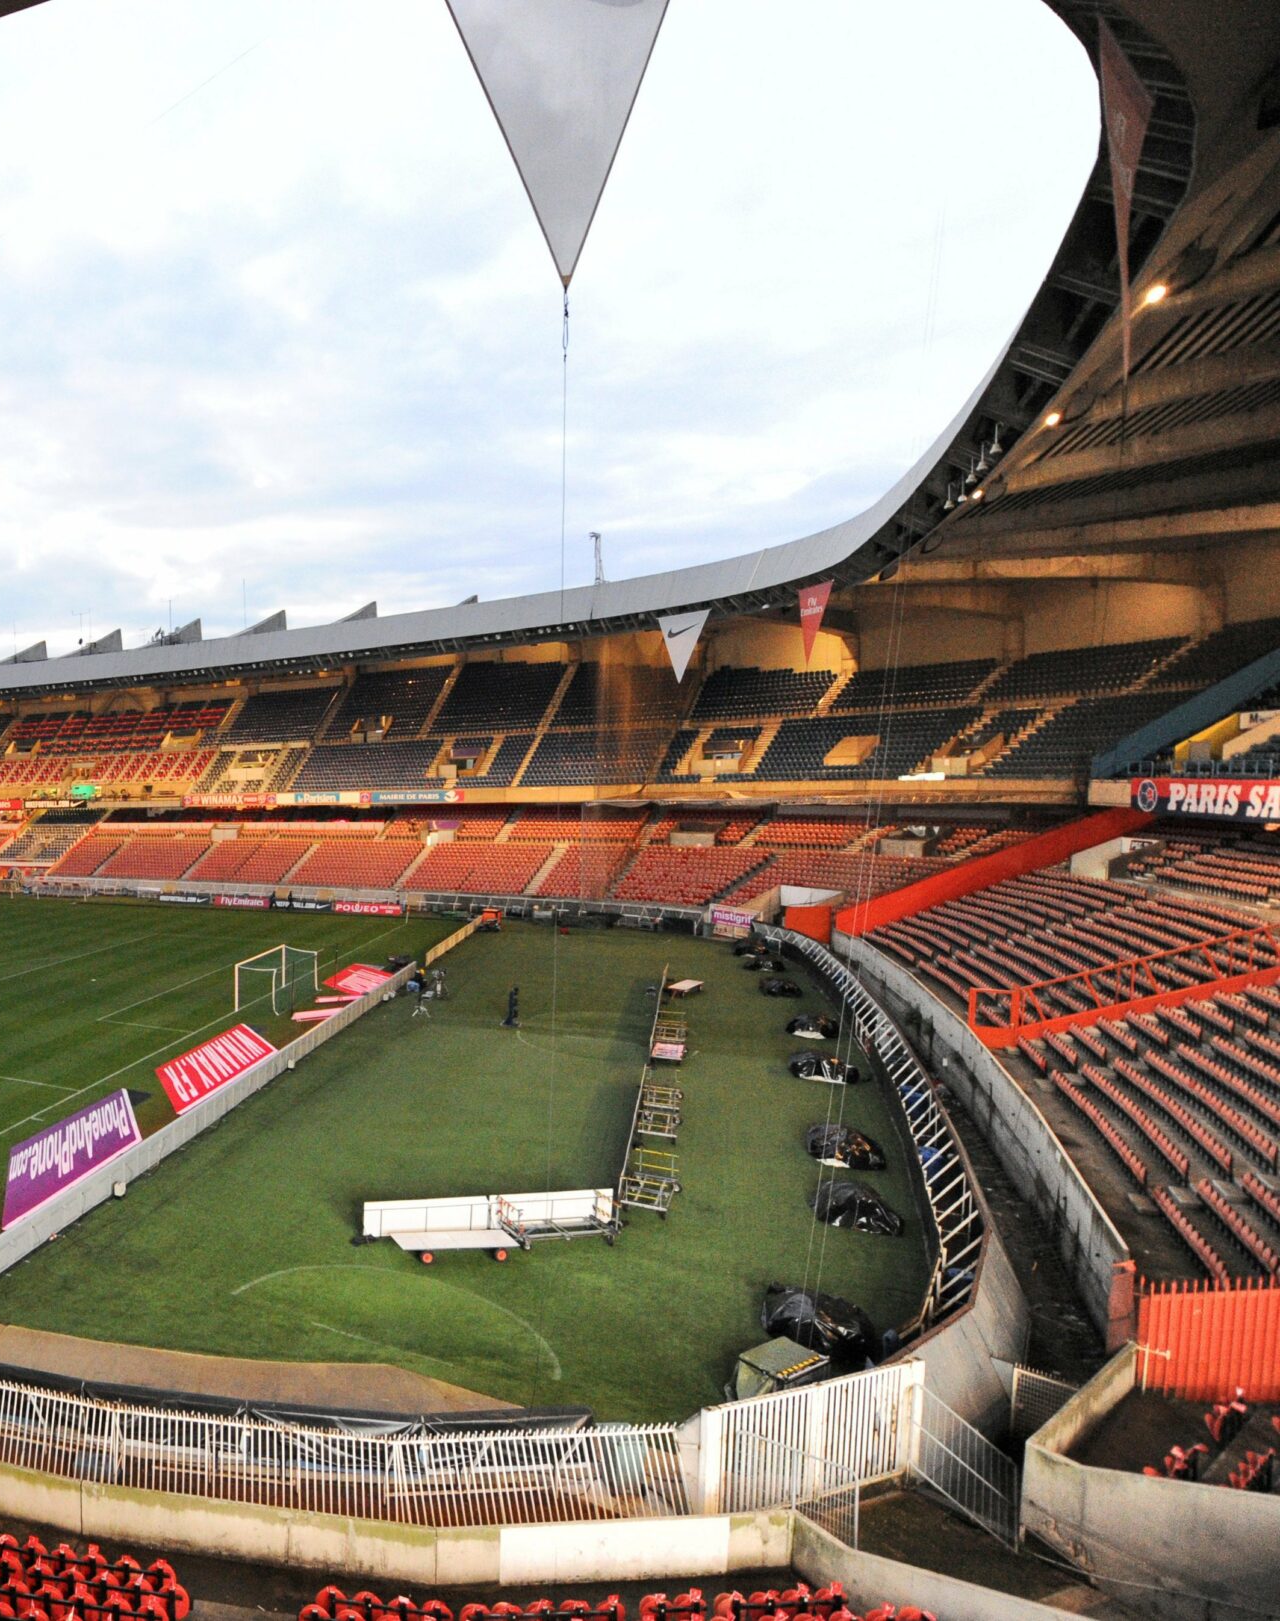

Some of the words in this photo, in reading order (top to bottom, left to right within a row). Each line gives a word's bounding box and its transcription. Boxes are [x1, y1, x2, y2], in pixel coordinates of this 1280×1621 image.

[200, 795, 244, 805] WINAMAX
[303, 792, 337, 803] Parisien
[1167, 783, 1242, 816] PARIS
[221, 896, 232, 907] Fly
[232, 897, 264, 906] Emirates
[335, 903, 379, 913] POWEO
[163, 1029, 266, 1103] WINAMAX.FR
[8, 1096, 131, 1182] PhoneAndPhone.com
